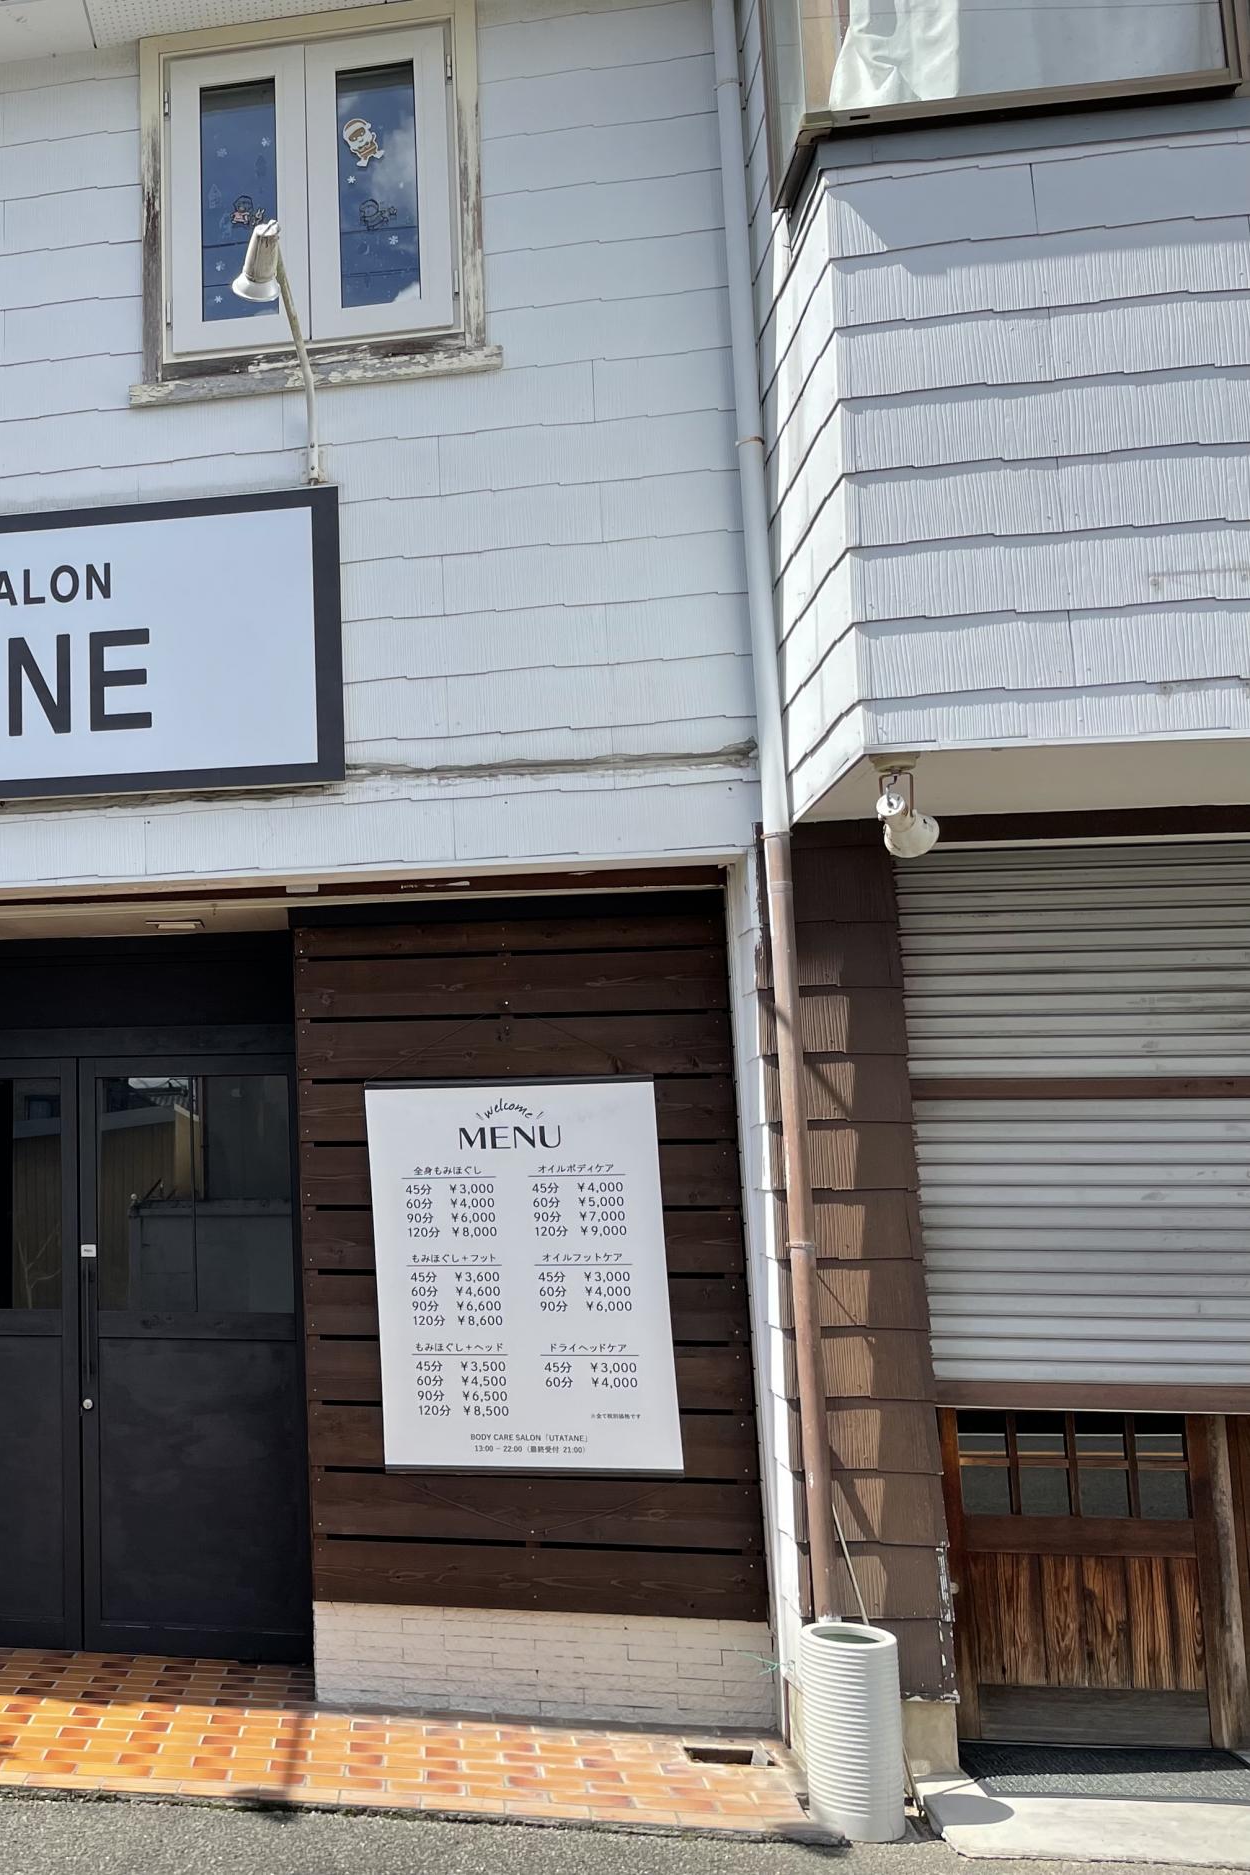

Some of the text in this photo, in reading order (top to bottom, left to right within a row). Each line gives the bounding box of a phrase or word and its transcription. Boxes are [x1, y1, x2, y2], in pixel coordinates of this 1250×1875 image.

[484, 1098, 533, 1119] welcome
[459, 1125, 561, 1150] MENU
[413, 1165, 482, 1176] 全身もみほぐし
[537, 1163, 614, 1174] オイルボディケア
[405, 1183, 495, 1196] 45分 ¥3,000
[531, 1181, 624, 1194] 45分 ¥4,000
[406, 1197, 495, 1210] 60分 ¥4,000
[532, 1195, 625, 1209] 60分 ¥5,000
[406, 1211, 496, 1225] 90分 ¥6,000
[533, 1210, 626, 1223] 90分 ¥7,000
[407, 1226, 498, 1239] 120分 ¥8,000
[534, 1224, 628, 1238] 120分 ¥9,000
[411, 1253, 496, 1264] もみほぐし+フット
[542, 1252, 623, 1263] オイルフットケア
[410, 1271, 500, 1284] 45分 ¥3,600
[537, 1271, 631, 1284] 45分 ¥3,000
[411, 1285, 501, 1298] 60分 ¥4,600
[539, 1285, 632, 1298] 60分 ¥4,000
[411, 1299, 502, 1313] 90分 ¥6,600
[539, 1300, 633, 1313] 90分 ¥6,000
[413, 1314, 503, 1328] 120分 ¥8,600
[415, 1341, 504, 1353] もみほぐし+ヘッド
[550, 1343, 627, 1353] ドライヘッドケア
[415, 1360, 507, 1373] 45分 ¥3,500
[543, 1361, 637, 1375] 45分 ¥3,000
[416, 1374, 507, 1388] 60分 ¥4,500
[545, 1375, 638, 1390] 60分 ¥4,000
[417, 1389, 508, 1403] 90分 ¥6,500
[418, 1404, 510, 1418] 120分 ¥8,500
[470, 1433, 490, 1441] BODY
[493, 1433, 514, 1441] CARE
[515, 1433, 542, 1442] SALON
[474, 1445, 494, 1453] 13:00
[503, 1445, 523, 1453] 22:00
